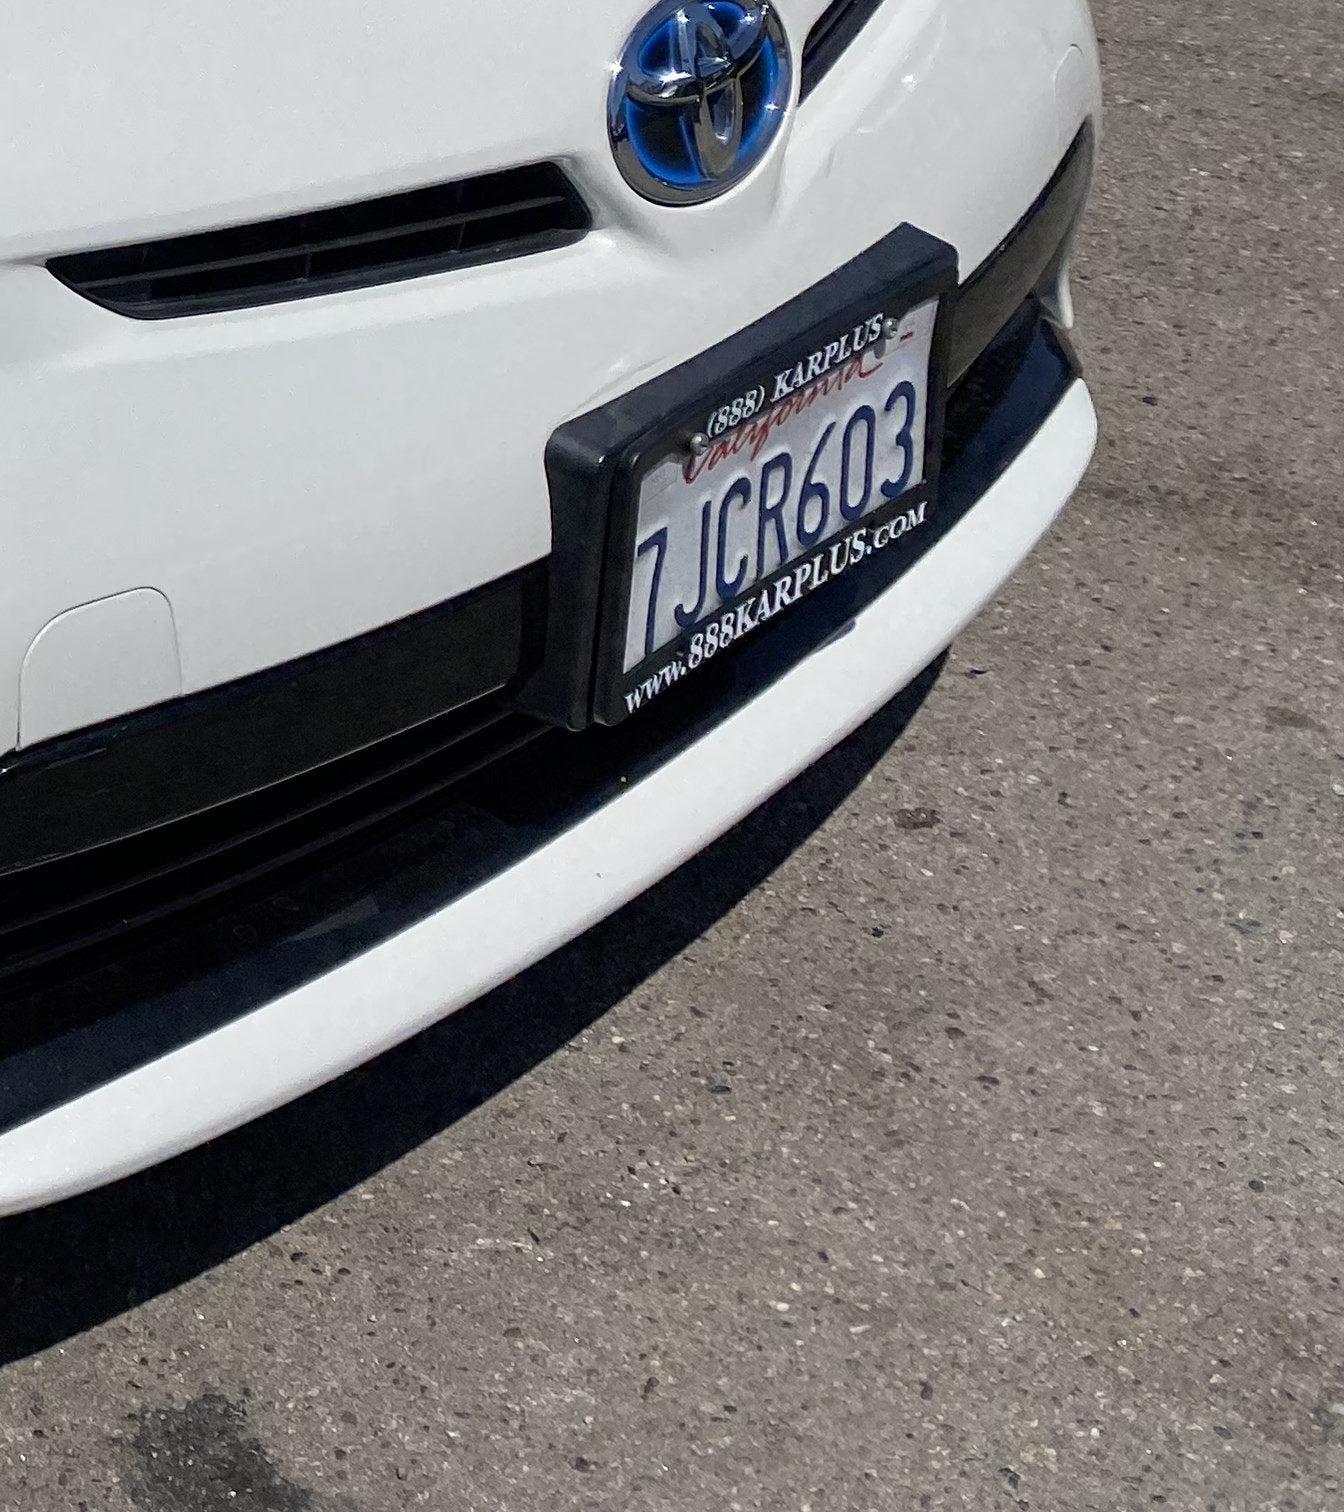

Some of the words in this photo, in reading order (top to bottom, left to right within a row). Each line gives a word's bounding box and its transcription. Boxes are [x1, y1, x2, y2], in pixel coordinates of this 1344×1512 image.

[707, 386, 766, 437] (888)
[769, 312, 884, 402] KARPLUS
[637, 381, 916, 657] 7JCR603
